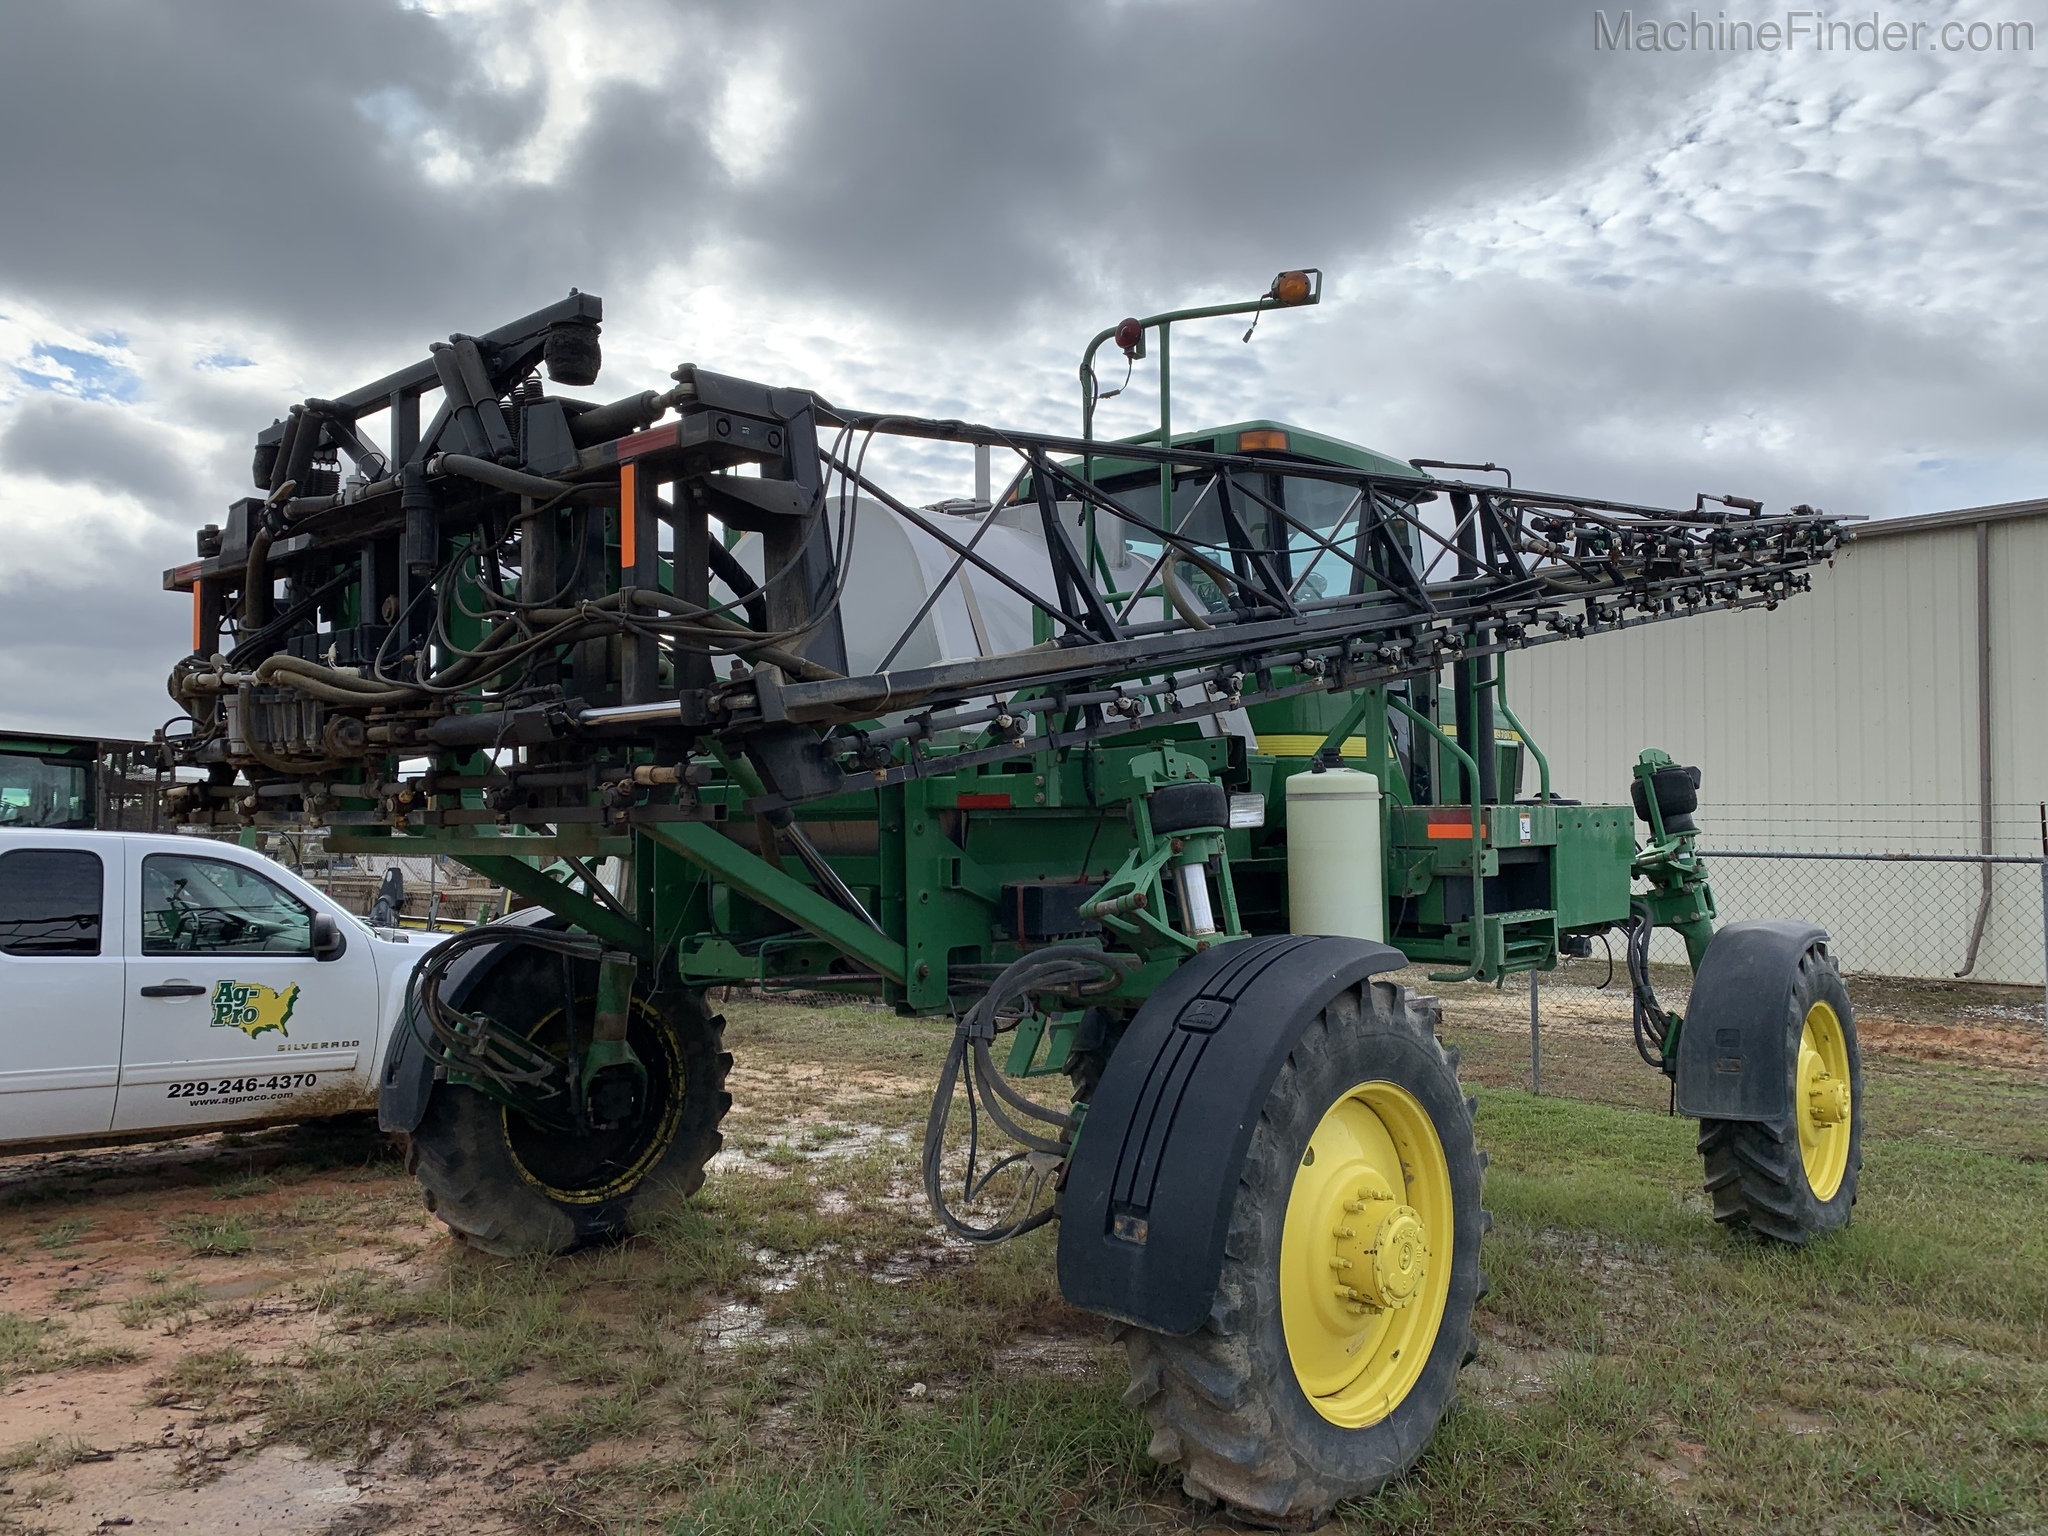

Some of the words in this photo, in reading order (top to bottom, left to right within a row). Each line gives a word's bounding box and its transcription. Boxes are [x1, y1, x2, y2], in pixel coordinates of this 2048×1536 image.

[212, 980, 259, 1008] Ag-
[211, 1003, 259, 1027] Pro
[277, 1039, 360, 1052] SILVERADO
[167, 1073, 317, 1099] 229-246-4370
[189, 1091, 294, 1107] www.agproco.com
